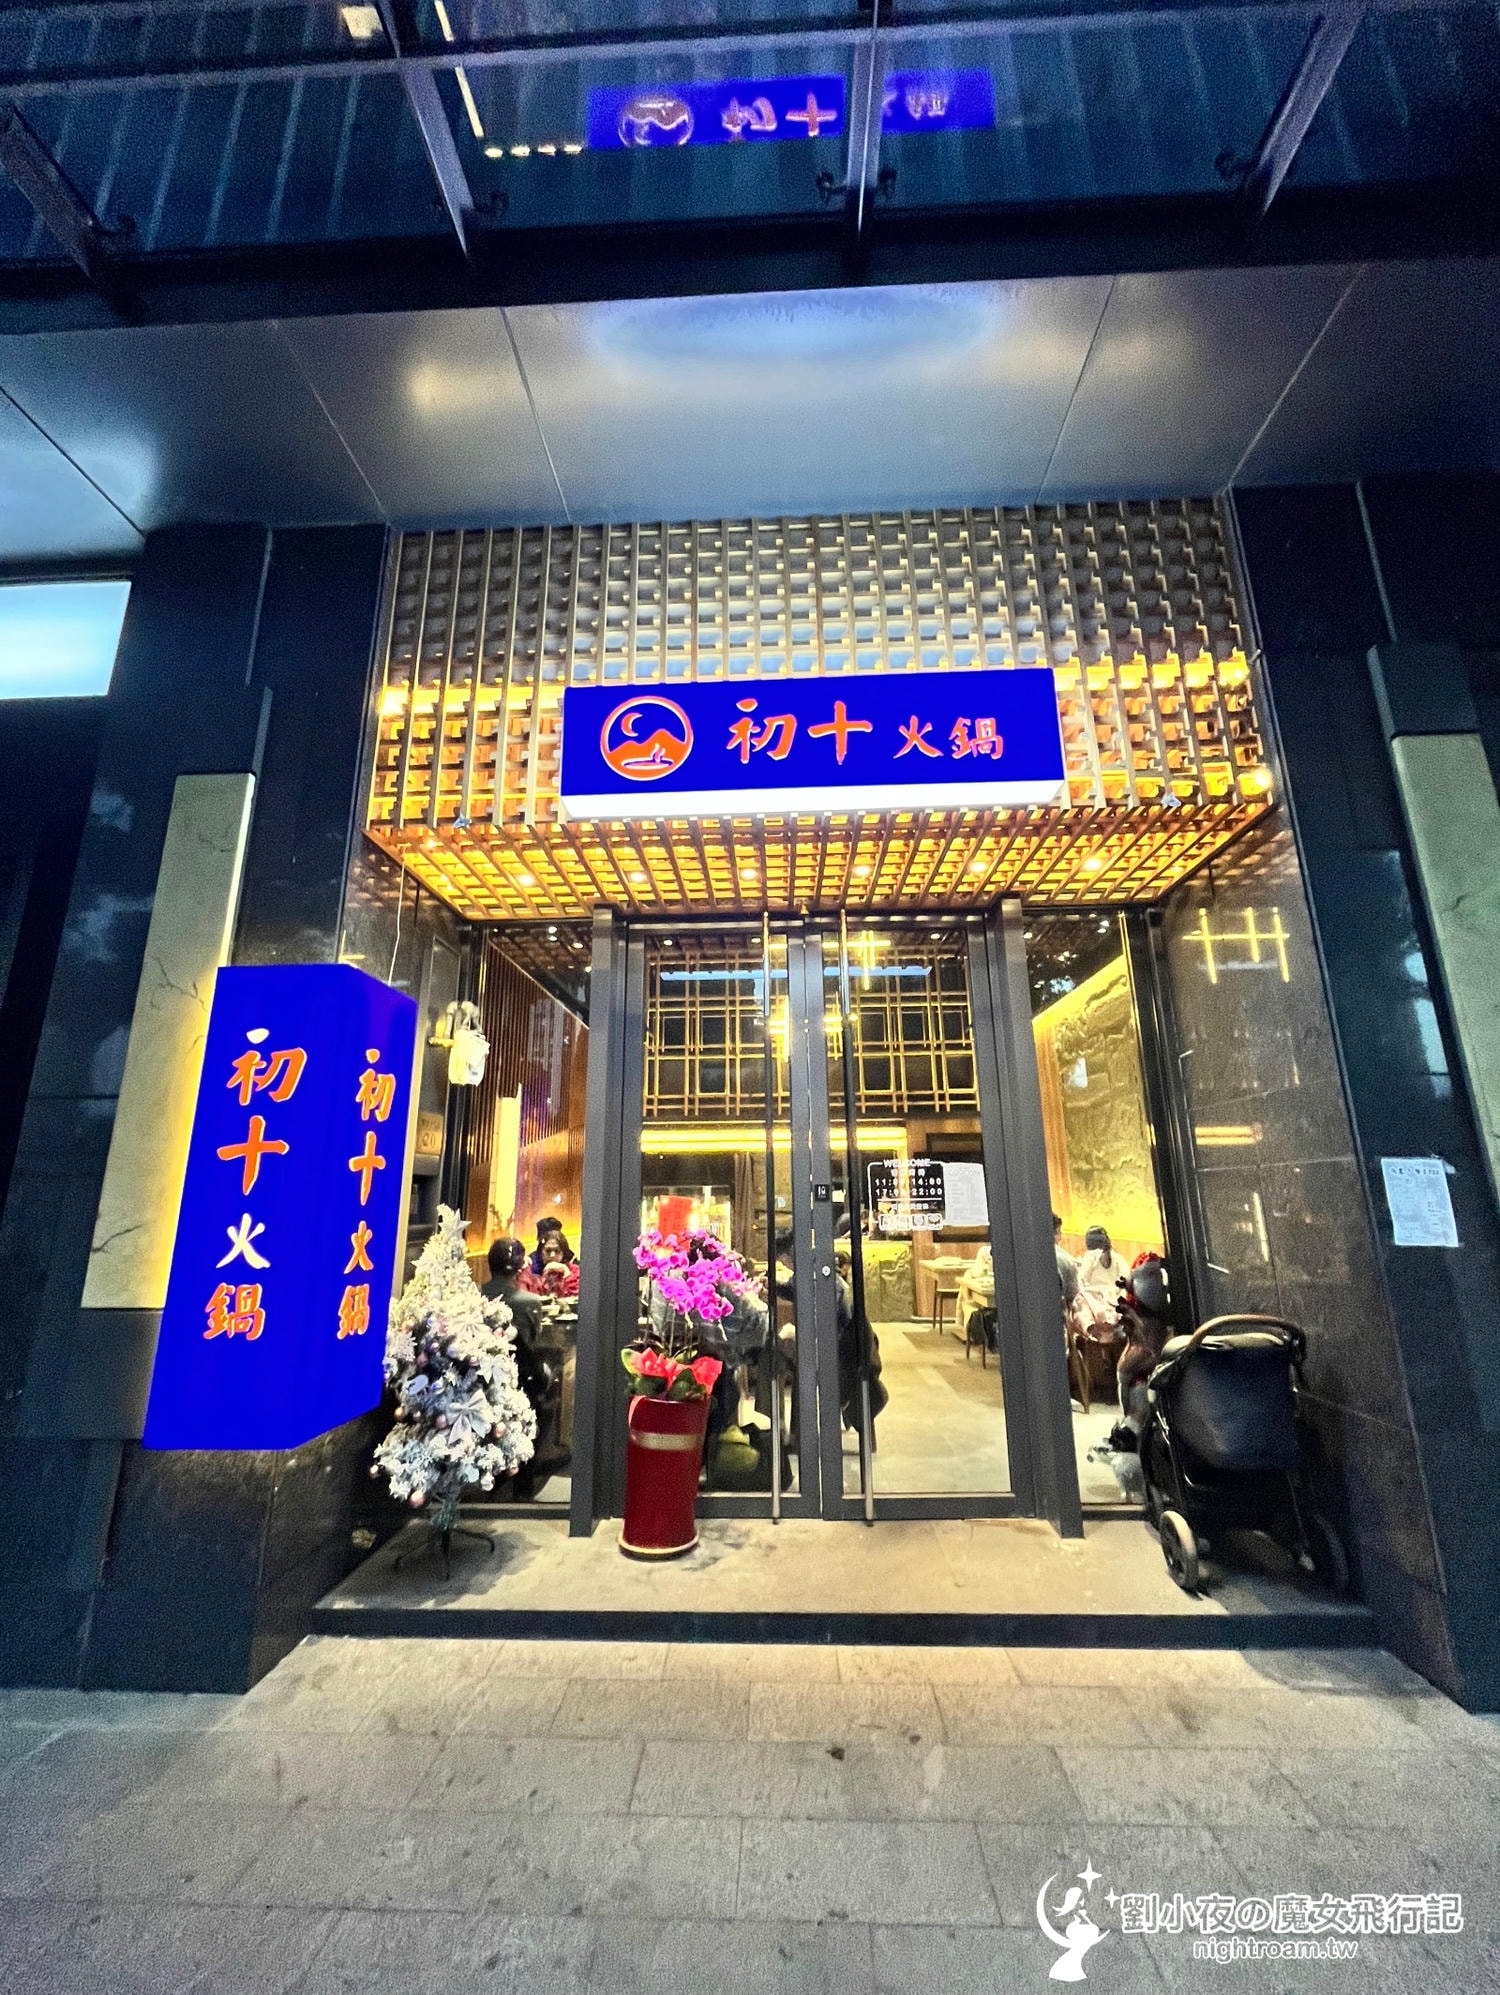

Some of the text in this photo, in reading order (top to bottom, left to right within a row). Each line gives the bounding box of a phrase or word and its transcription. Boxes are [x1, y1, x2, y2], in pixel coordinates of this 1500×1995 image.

[727, 698, 1003, 764] 初十火鍋
[203, 1028, 307, 1340] 初十火鍋
[337, 1049, 396, 1340] 初十火鍋
[883, 1158, 931, 1168] WEOME
